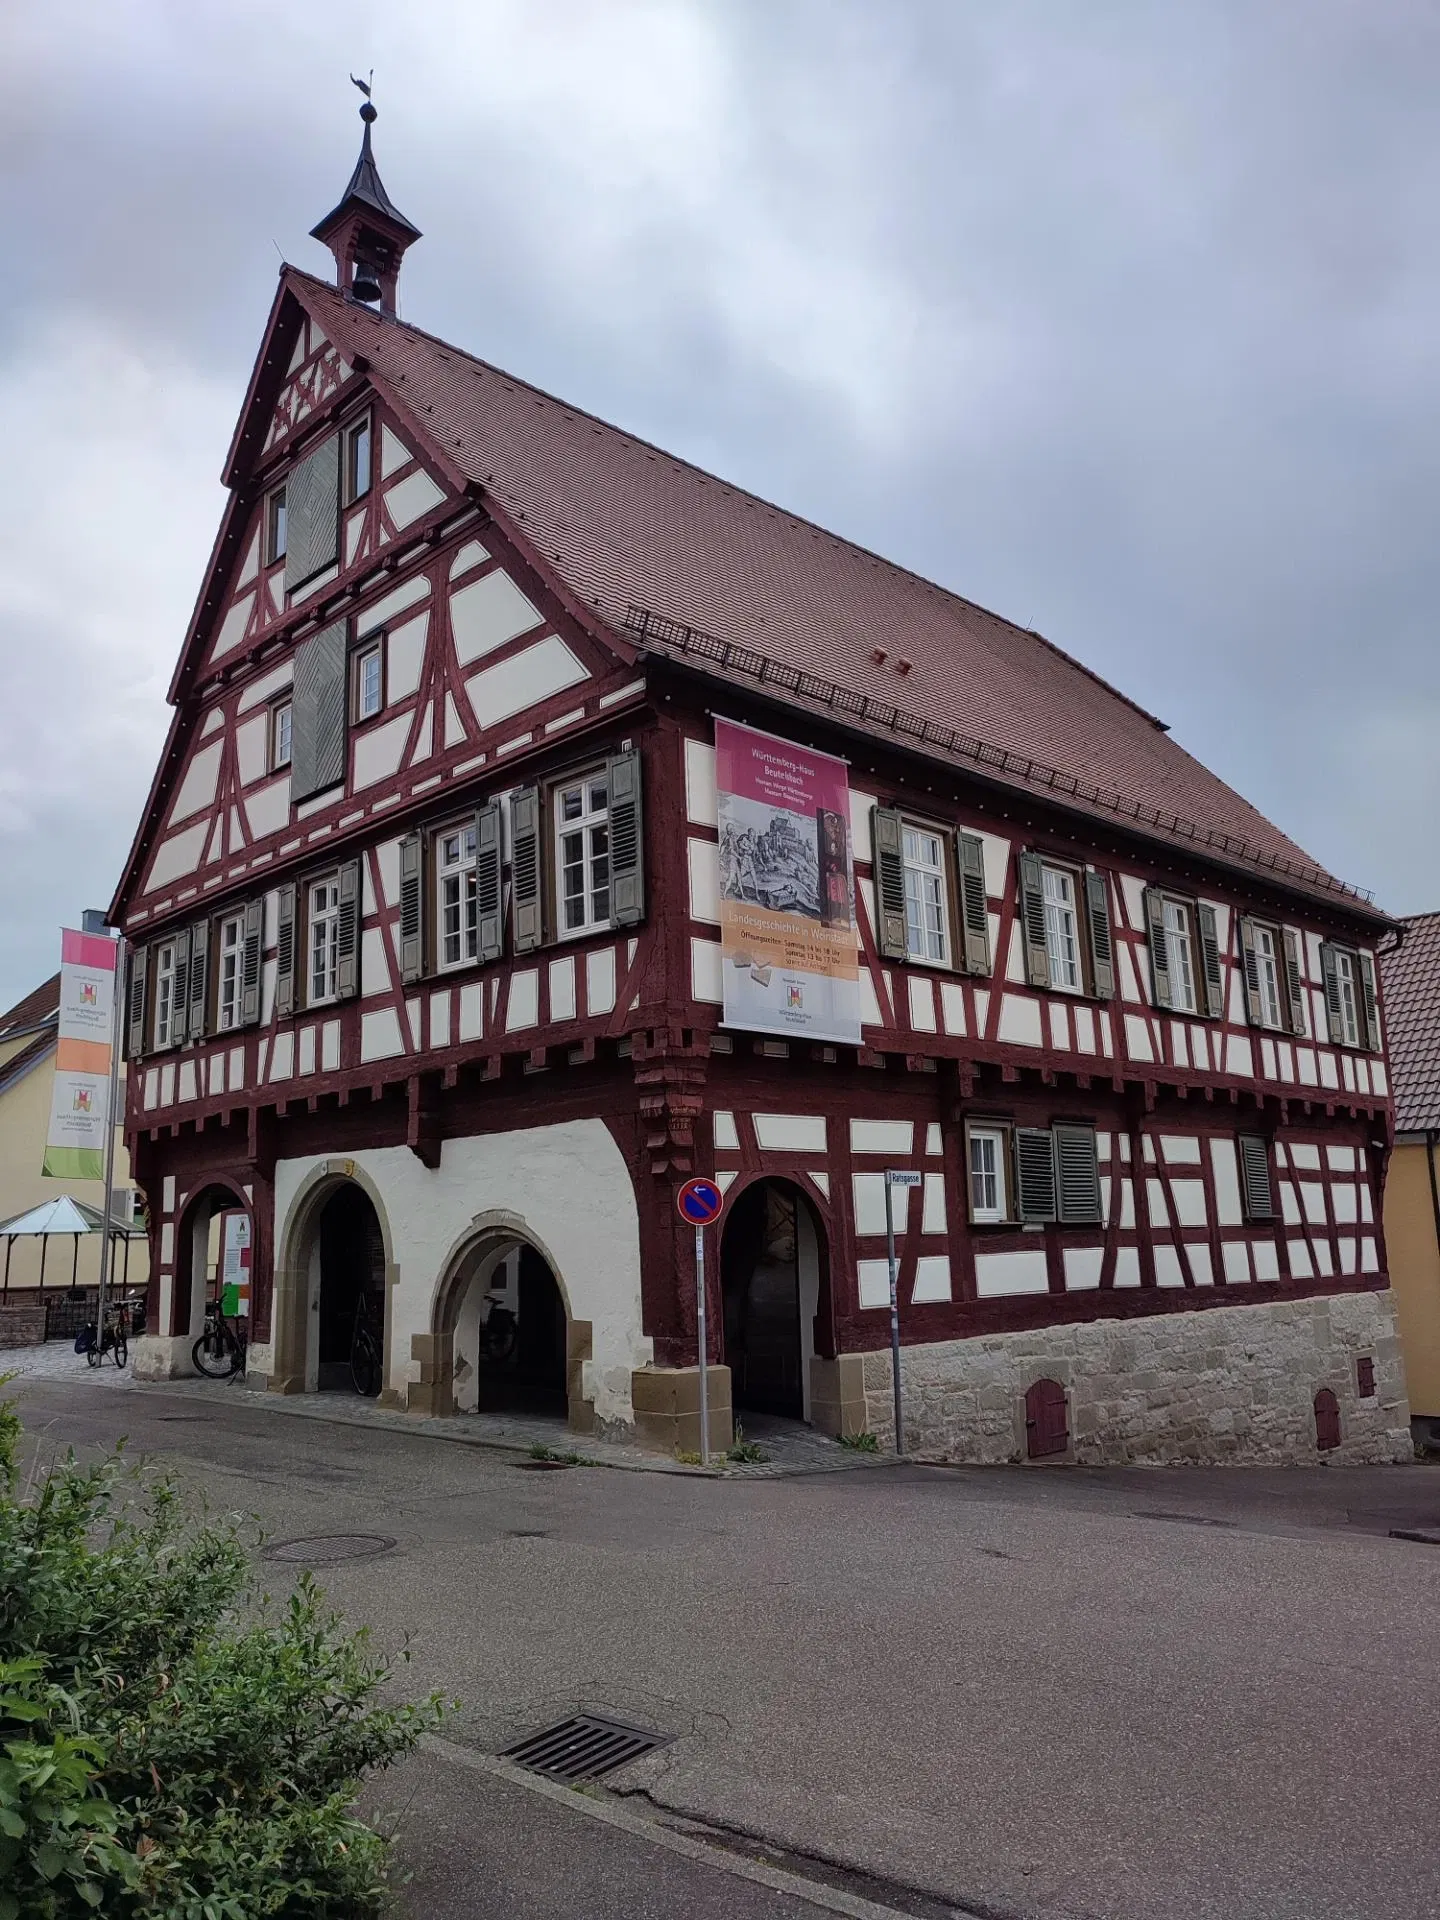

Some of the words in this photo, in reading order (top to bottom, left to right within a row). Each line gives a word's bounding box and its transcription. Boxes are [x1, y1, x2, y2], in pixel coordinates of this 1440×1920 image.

[752, 748, 815, 776] Württemberg-Haus
[765, 765, 804, 785] Beutelsbach
[729, 910, 800, 934] Landesgeschichte
[801, 928, 809, 937] in
[811, 927, 848, 944] Weinstadt
[784, 939, 805, 951] Samstag
[832, 947, 840, 956] Uhr
[832, 955, 841, 964] Uhr
[892, 1173, 920, 1185] Ratsgasse
